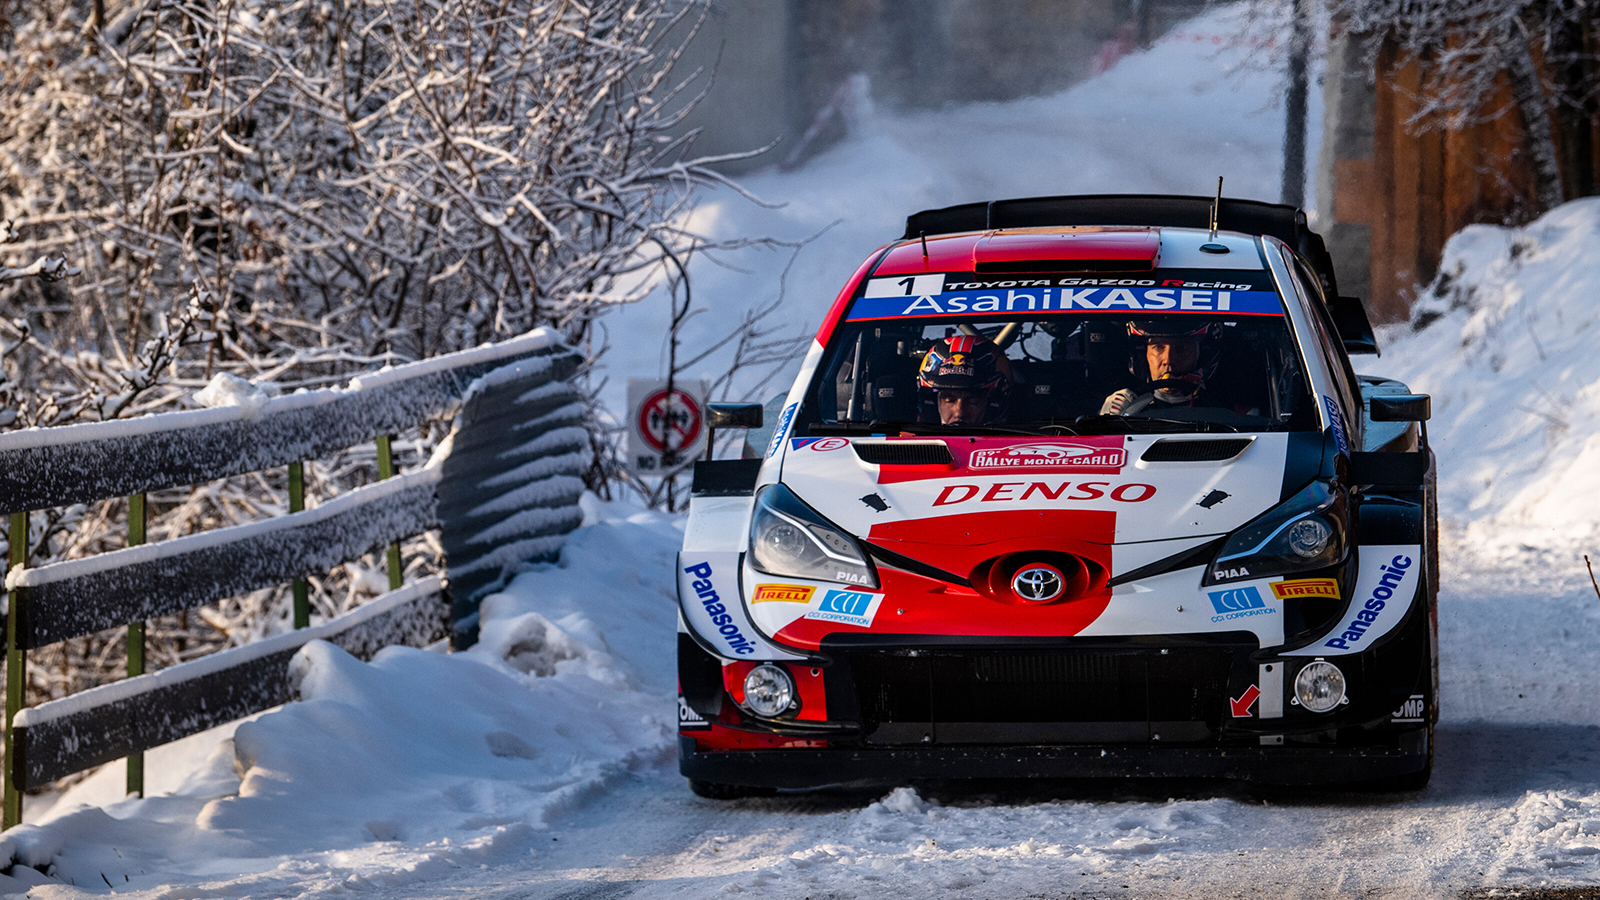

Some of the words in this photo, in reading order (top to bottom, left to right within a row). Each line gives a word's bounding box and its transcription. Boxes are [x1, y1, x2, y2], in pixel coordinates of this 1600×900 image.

[898, 277, 916, 296] 1
[945, 279, 1051, 290] TOYOTA
[1058, 277, 1155, 286] GAZOO
[1162, 279, 1252, 291] Racing
[975, 456, 1020, 467] RALLYE
[931, 481, 1157, 507] DENSO
[836, 571, 868, 584] PIAA
[1214, 566, 1250, 580] PIAA
[754, 586, 811, 601] PIRELLI
[1274, 581, 1336, 597] PIRELLI
[683, 561, 757, 655] Panasonic
[1324, 554, 1412, 650] Panasonic
[821, 612, 871, 626] CORPORATION
[1225, 607, 1277, 621] CORPORATION
